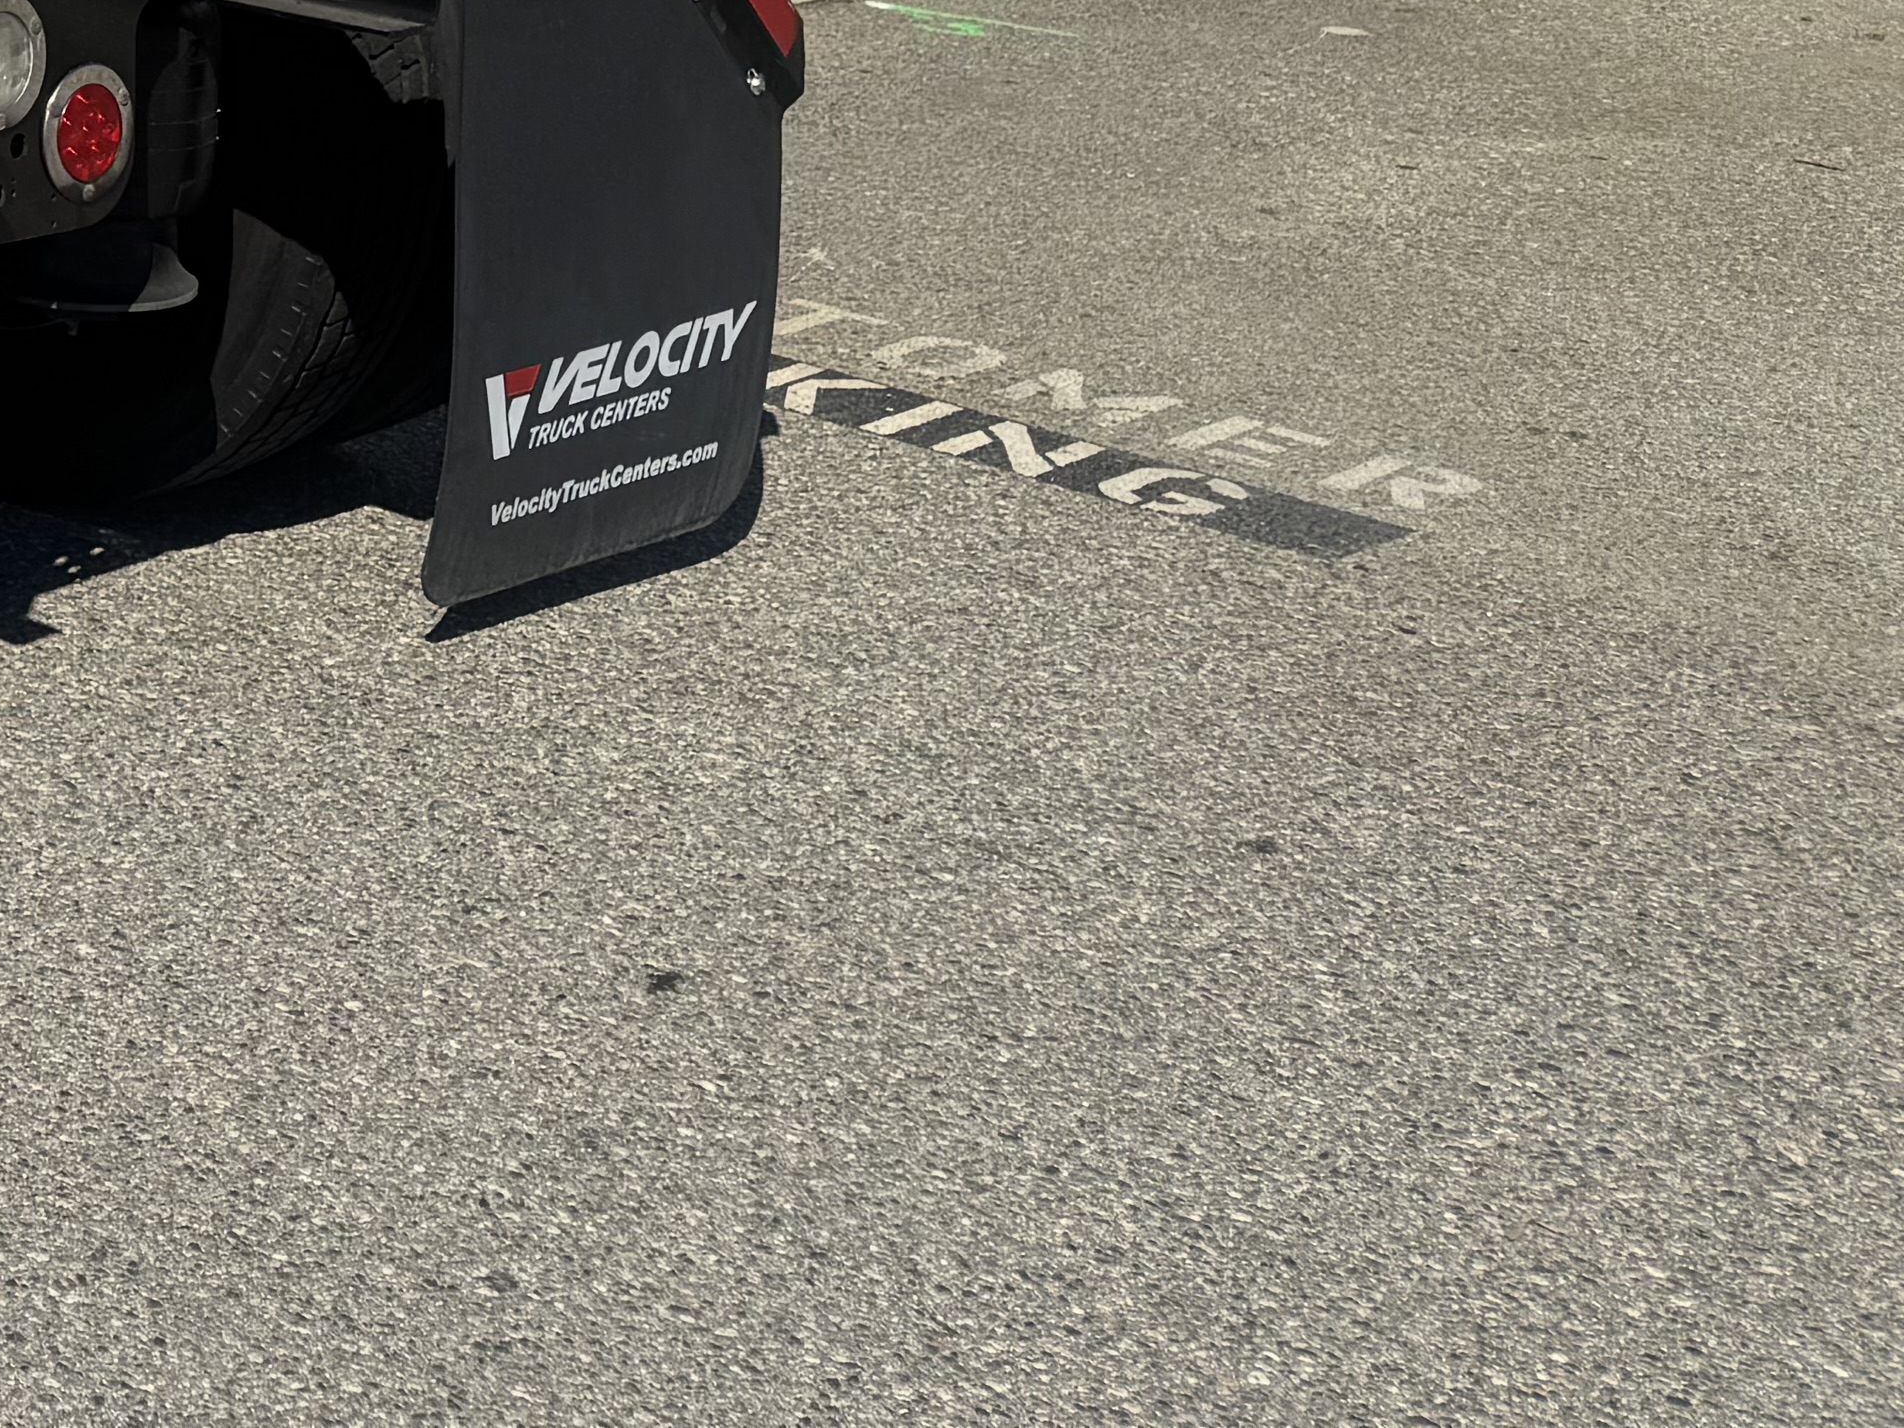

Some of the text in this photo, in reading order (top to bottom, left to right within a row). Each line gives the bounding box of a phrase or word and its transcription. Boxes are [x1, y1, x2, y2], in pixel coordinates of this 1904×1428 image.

[538, 300, 757, 415] VELOCITY
[774, 297, 1484, 510] TOMER
[527, 386, 672, 450] TRUCK CENTERS
[764, 362, 1250, 516] KING
[491, 441, 719, 526] VelocityTruckCenters.com
